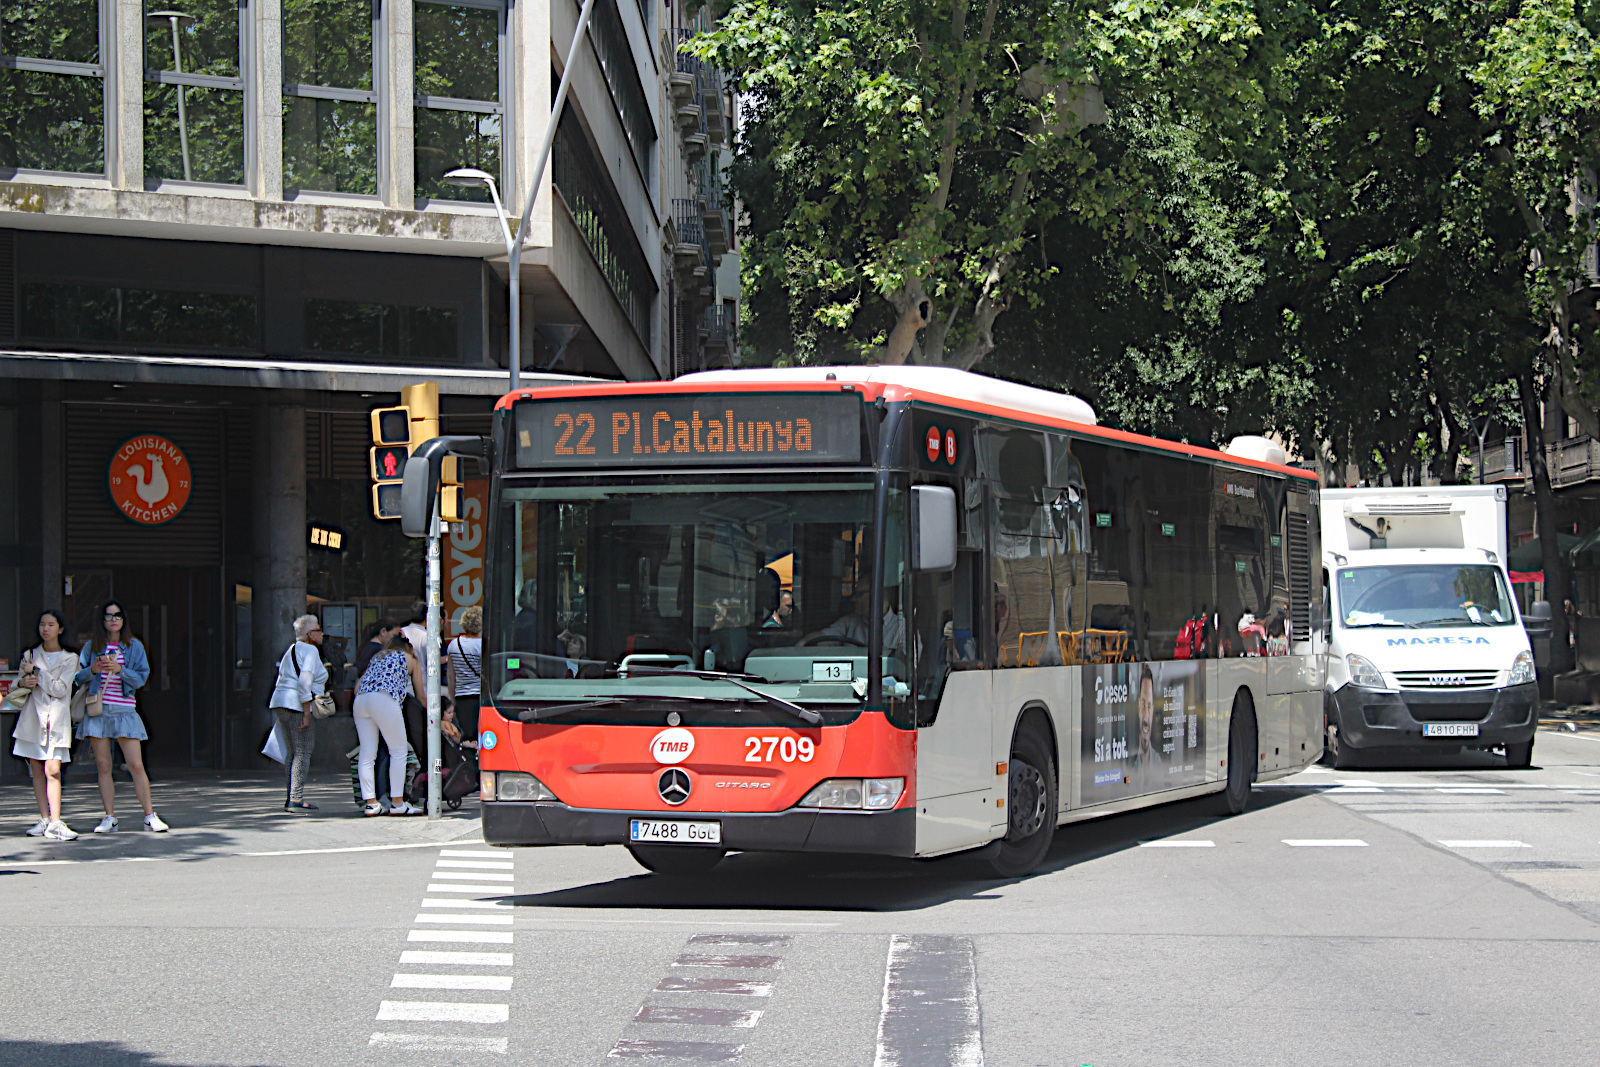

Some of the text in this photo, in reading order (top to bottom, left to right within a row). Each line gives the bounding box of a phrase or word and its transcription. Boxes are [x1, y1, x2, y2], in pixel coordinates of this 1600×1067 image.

[554, 413, 596, 455] 22
[119, 438, 182, 465] LOUISIANA
[929, 438, 939, 450] TMB
[947, 436, 954, 457] B
[112, 477, 121, 485] 19
[179, 480, 188, 488] 72
[122, 500, 178, 521] KITCHEN
[1386, 637, 1491, 646] MARESA
[825, 666, 840, 678] 13
[1429, 677, 1467, 685] IVECO
[1104, 684, 1128, 704] cesce
[659, 742, 689, 752] TMB
[744, 736, 815, 762] 2709
[1094, 736, 1128, 763] Sí a tot.
[641, 822, 679, 839] 7488
